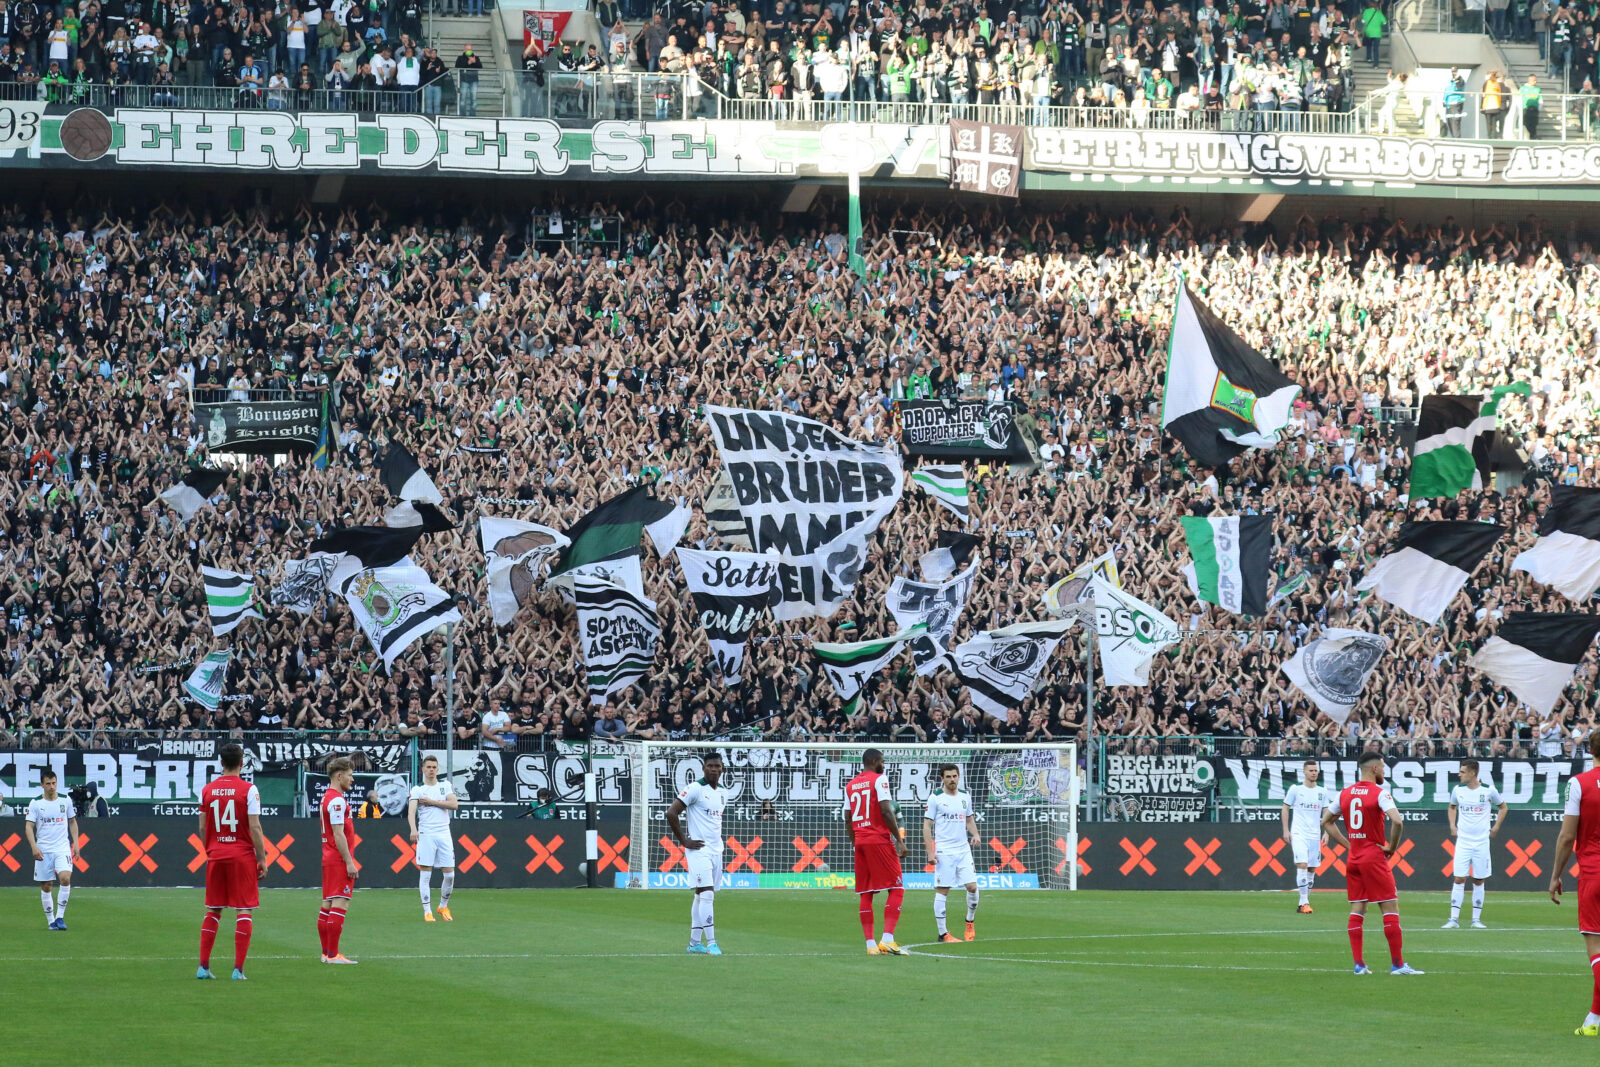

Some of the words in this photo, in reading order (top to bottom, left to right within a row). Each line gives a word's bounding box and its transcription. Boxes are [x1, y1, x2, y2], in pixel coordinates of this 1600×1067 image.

[114, 108, 361, 169] EHRE
[377, 113, 568, 174] DER
[1030, 126, 1494, 182] BETRETUNGSVERBOTE
[237, 406, 319, 425] Borussen
[235, 419, 319, 437] Knights
[911, 422, 977, 443] SUPPORTERS
[728, 453, 896, 505] BRÜDER
[744, 510, 878, 556] IMM
[702, 556, 774, 588] Sott
[700, 603, 762, 634] cult
[163, 740, 215, 754] BANDA
[1107, 755, 1197, 775] BEGLEIT
[211, 788, 236, 796] HECTOR
[1107, 774, 1194, 793] SERVICE
[453, 807, 503, 819] latex
[850, 789, 871, 822] 27
[1140, 795, 1206, 813] HEUTE
[1349, 797, 1363, 830] 6
[209, 799, 239, 833] 14
[1022, 808, 1080, 822] flate
[1141, 810, 1200, 822] GEHT
[1236, 810, 1280, 821] fatex
[814, 874, 855, 887] TRIBO
